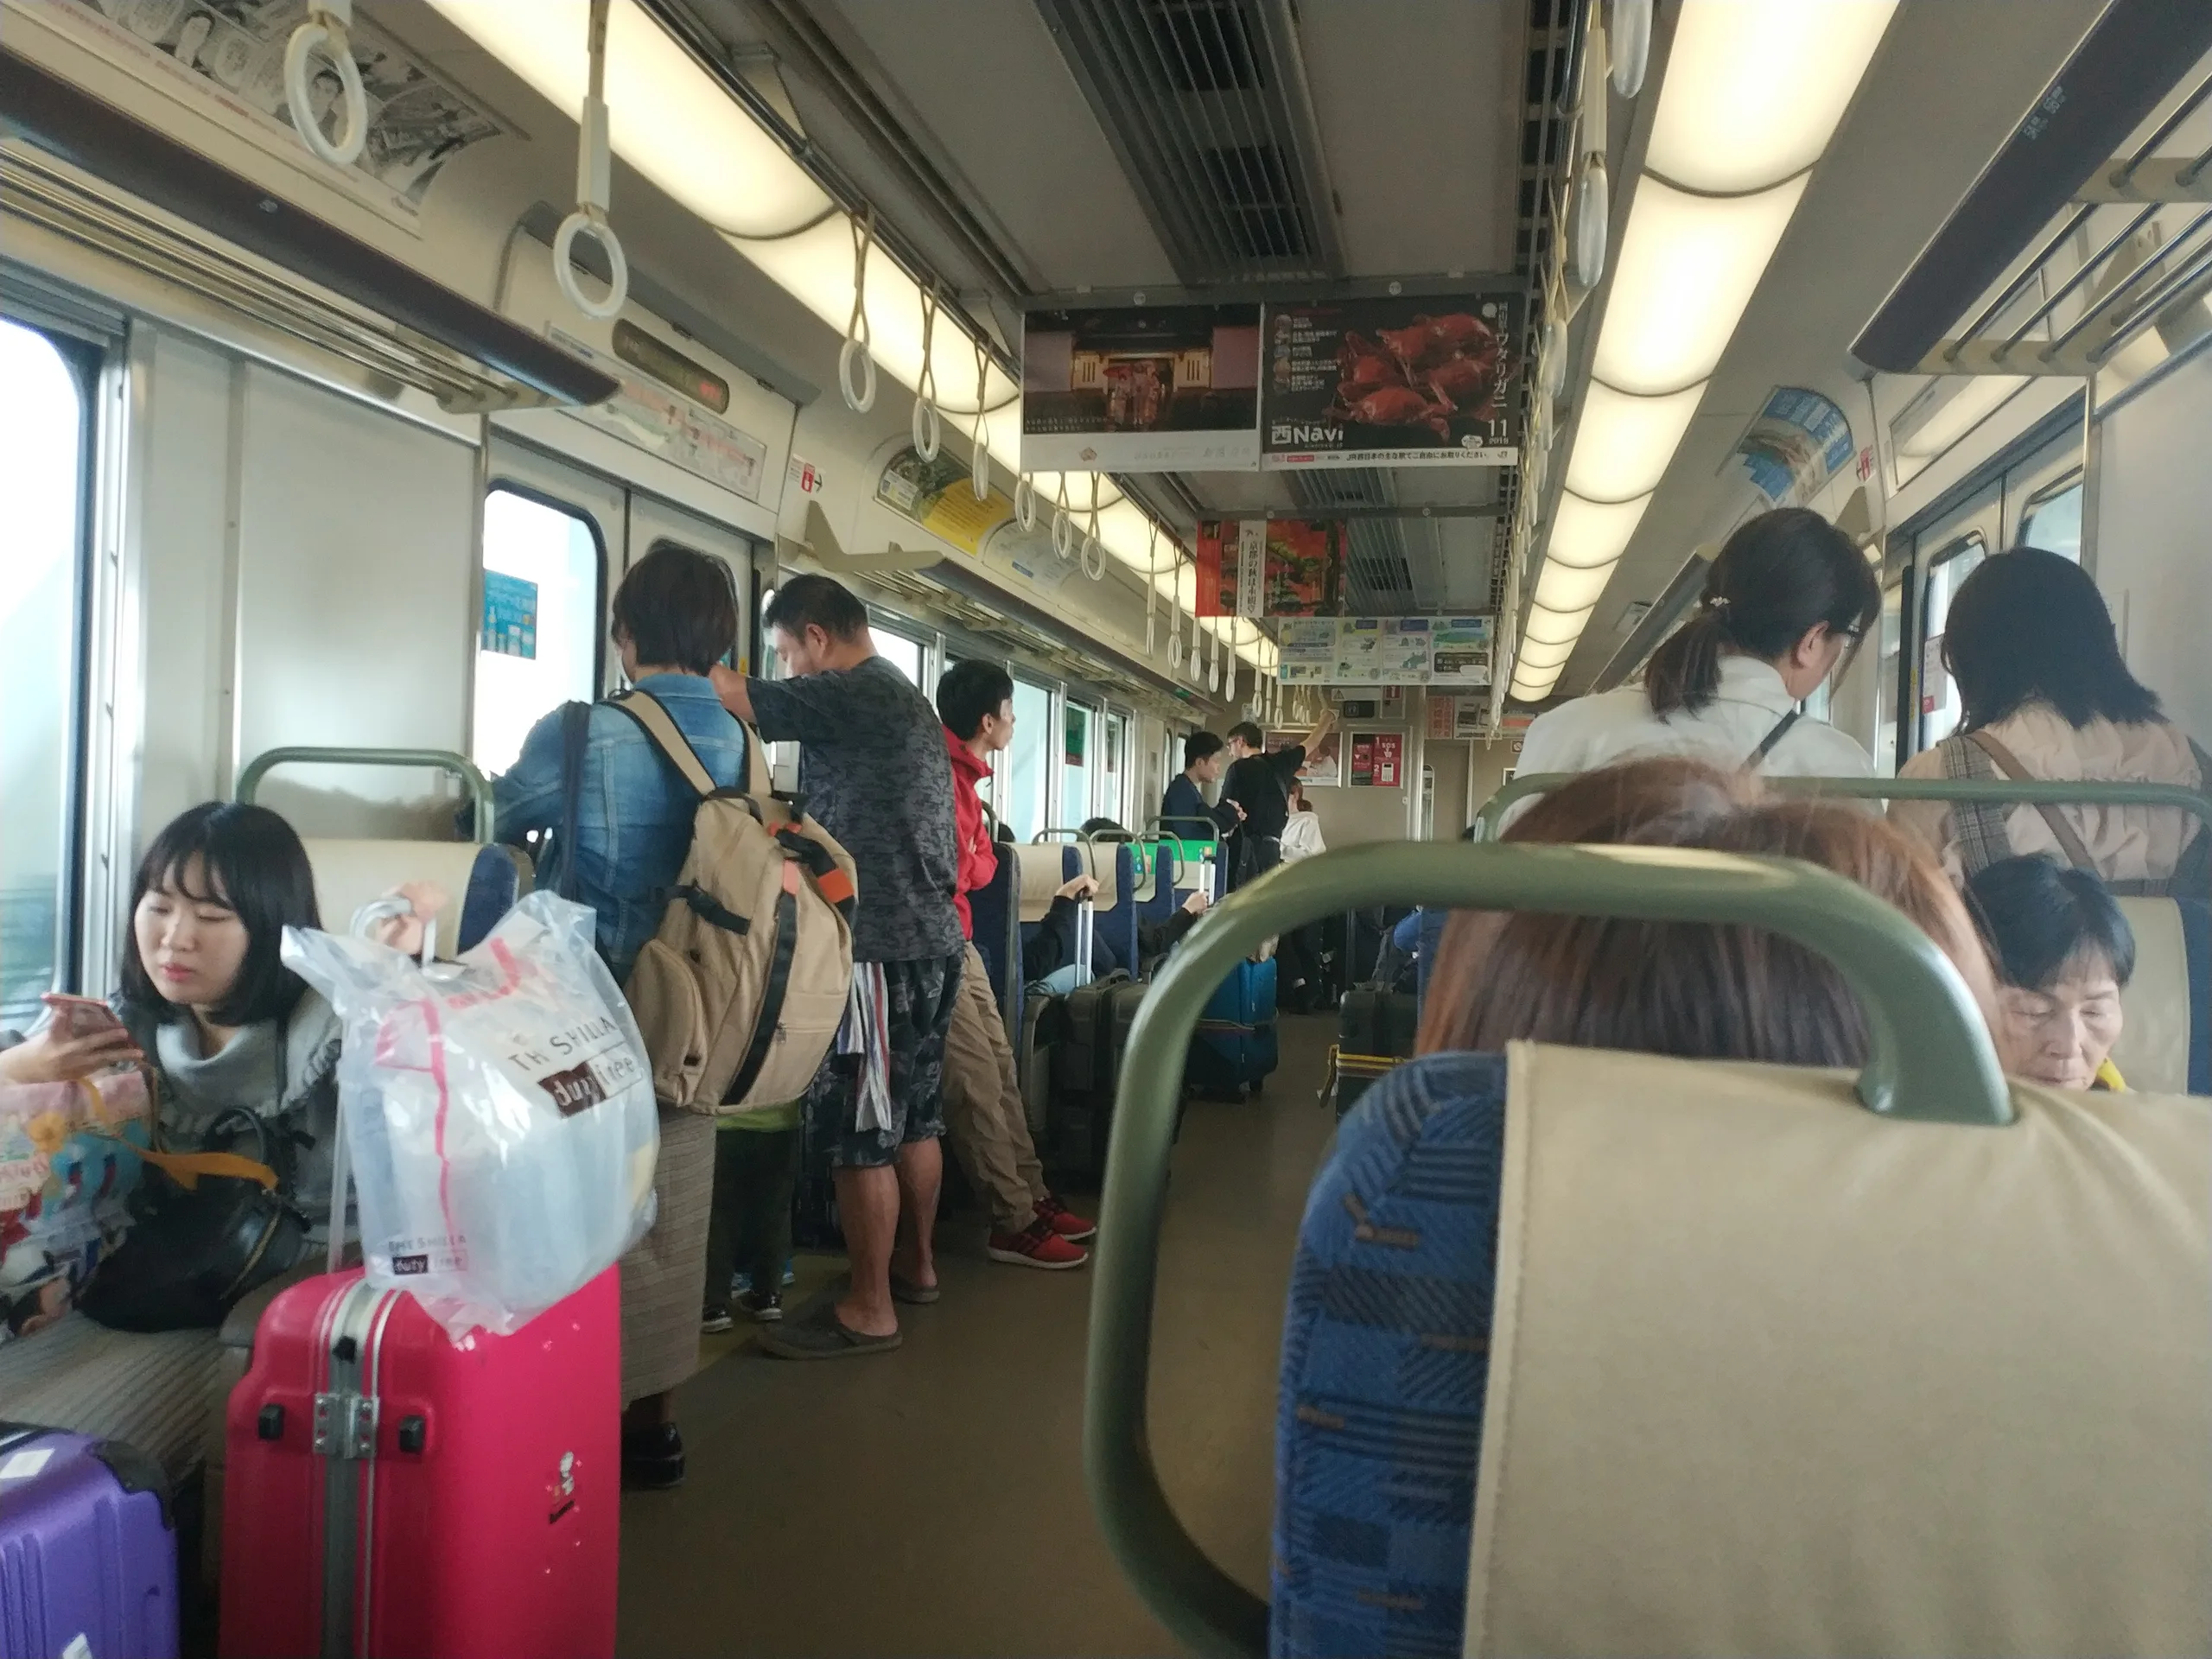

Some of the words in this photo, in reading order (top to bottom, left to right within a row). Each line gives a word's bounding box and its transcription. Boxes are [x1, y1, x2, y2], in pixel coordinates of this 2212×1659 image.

[1488, 419, 1508, 437] 11
[1376, 736, 1380, 747] 1
[508, 1050, 550, 1071] TH
